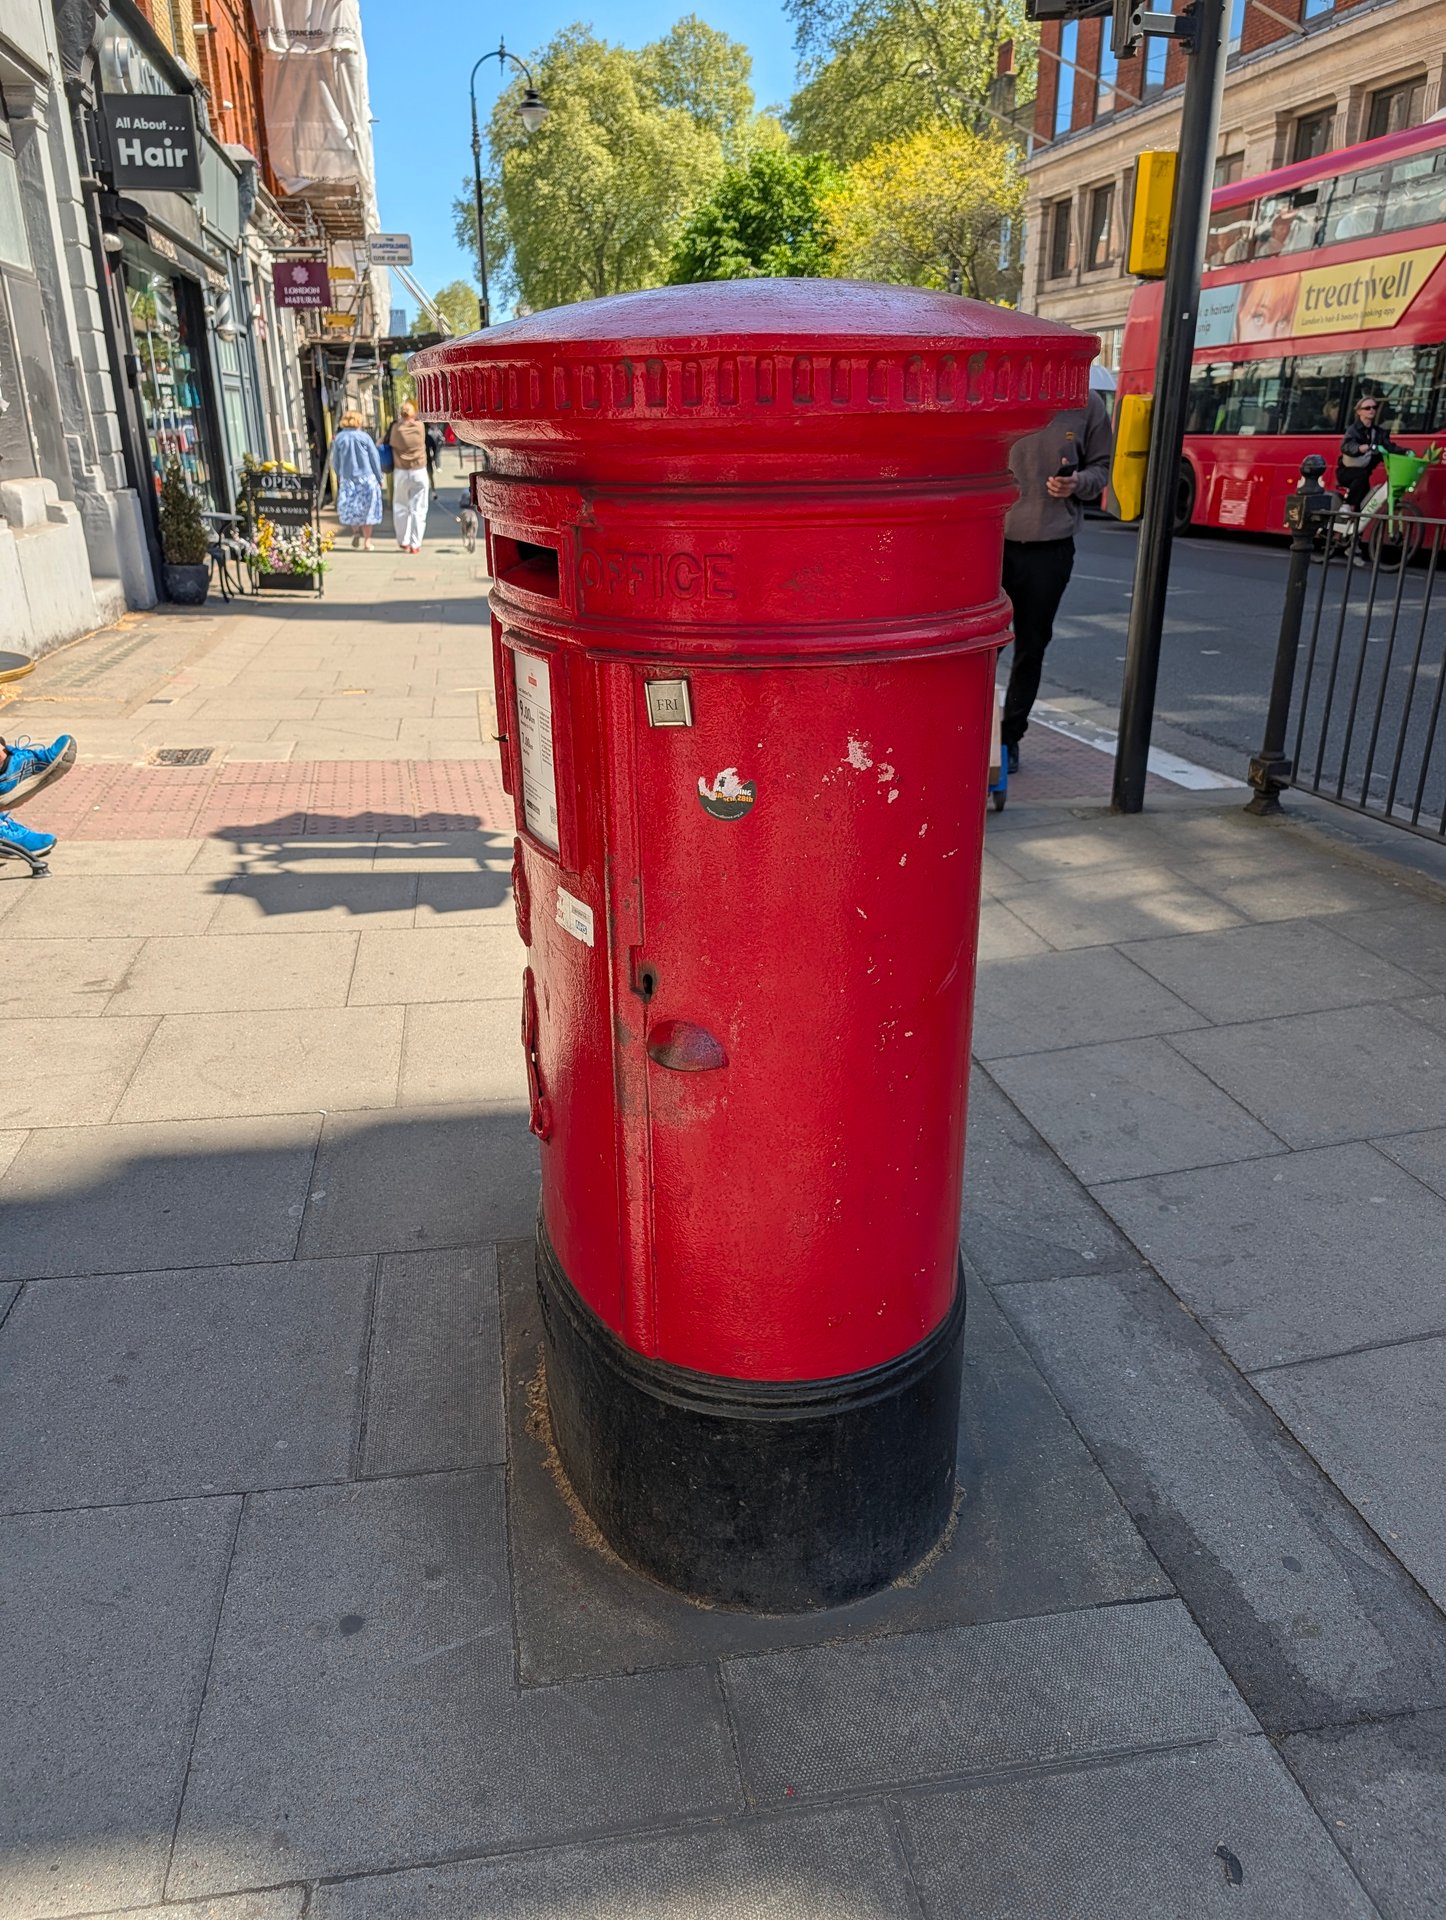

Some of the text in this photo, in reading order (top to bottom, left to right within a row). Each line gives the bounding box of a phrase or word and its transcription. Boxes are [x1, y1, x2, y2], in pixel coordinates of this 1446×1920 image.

[116, 116, 131, 129] All
[117, 137, 189, 168] Hair
[283, 286, 321, 295] LONDON
[1304, 260, 1414, 311] treatwell
[284, 296, 323, 305] NATURAL
[1210, 302, 1235, 316] haircut
[1301, 316, 1325, 327] London's
[1324, 314, 1335, 323] hair
[1340, 311, 1360, 323] beauty
[1383, 306, 1396, 318] app
[261, 475, 301, 489] OPEN
[258, 505, 309, 515] MEN & WOMEN
[579, 551, 736, 600] OFFICE
[656, 698, 679, 712] FRI
[737, 795, 754, 803] 28th
